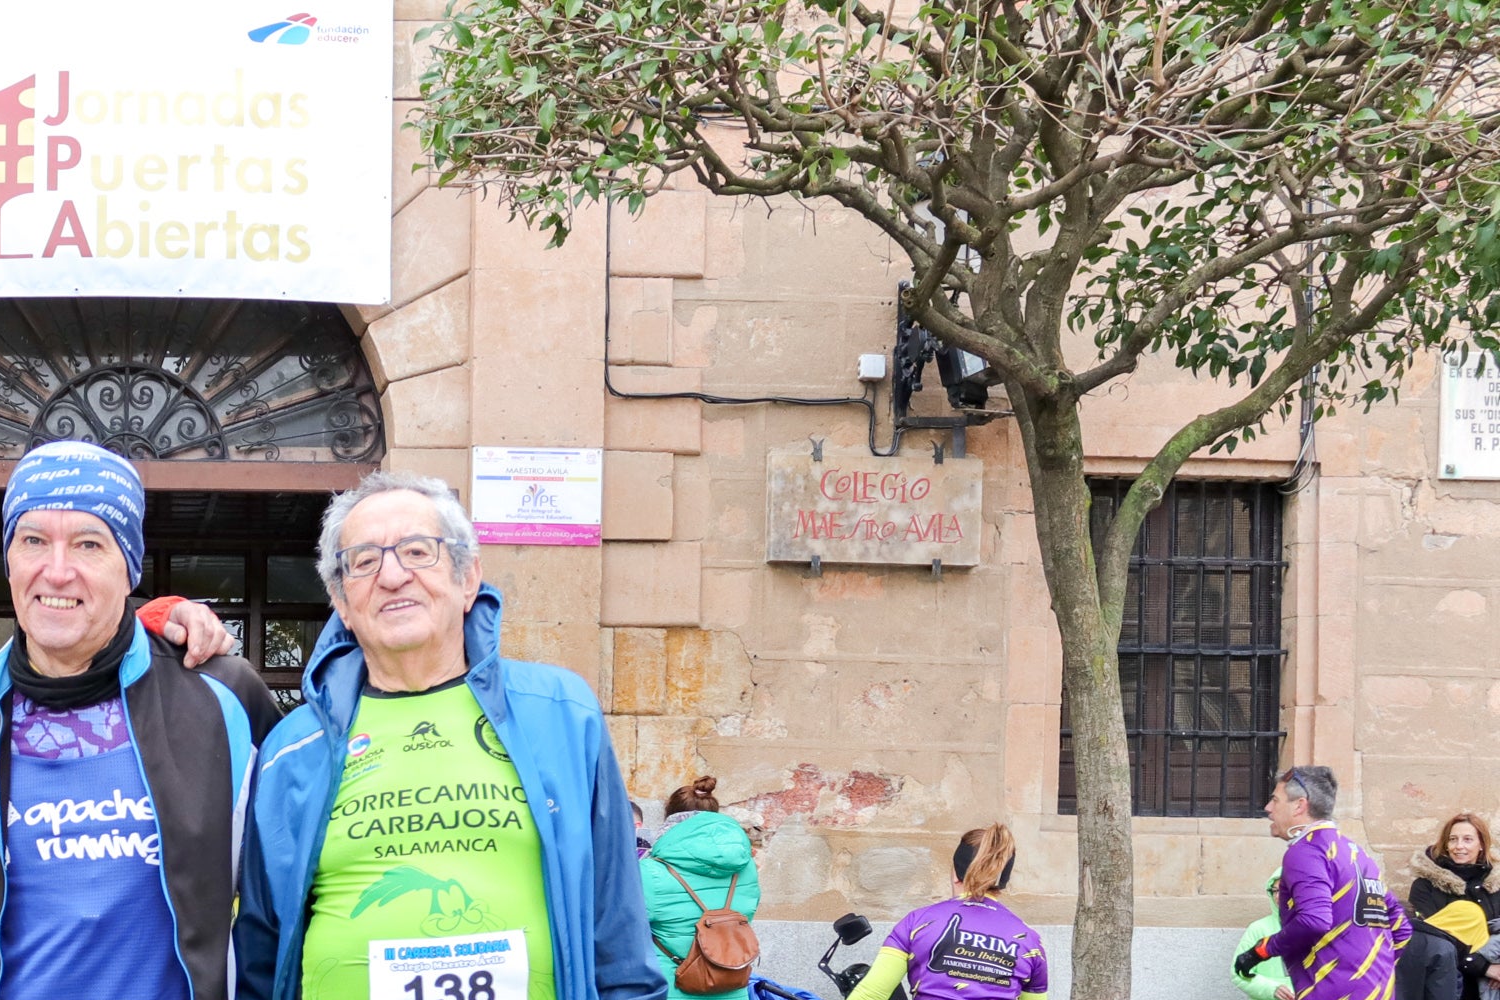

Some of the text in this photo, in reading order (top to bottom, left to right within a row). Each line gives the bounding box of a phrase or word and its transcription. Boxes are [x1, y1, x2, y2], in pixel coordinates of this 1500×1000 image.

[317, 25, 370, 35] fundación
[317, 34, 360, 43] educere
[43, 68, 311, 129] Jornadas
[46, 135, 310, 196] Puertas
[41, 195, 313, 264] Abiertas
[1455, 409, 1476, 420] SUS
[1471, 423, 1484, 434] EL
[25, 467, 81, 483] valsir
[97, 469, 133, 490] valsir
[506, 467, 544, 475] MAESTRO
[92, 502, 129, 526] valsir
[792, 510, 896, 541] MAESTRO
[347, 808, 524, 840] CARBAJOSA
[36, 829, 161, 866] running
[374, 838, 498, 859] SALAMANCA
[397, 944, 452, 960] CARRERA
[453, 939, 511, 957] SOLIDARIA
[958, 930, 1019, 957] PRIM
[390, 955, 506, 973] Colegio Maestro Ávila
[942, 959, 972, 970] JAMONES
[954, 946, 1015, 968] Oro Ibérico
[948, 969, 1010, 986] dehesadeprim.com
